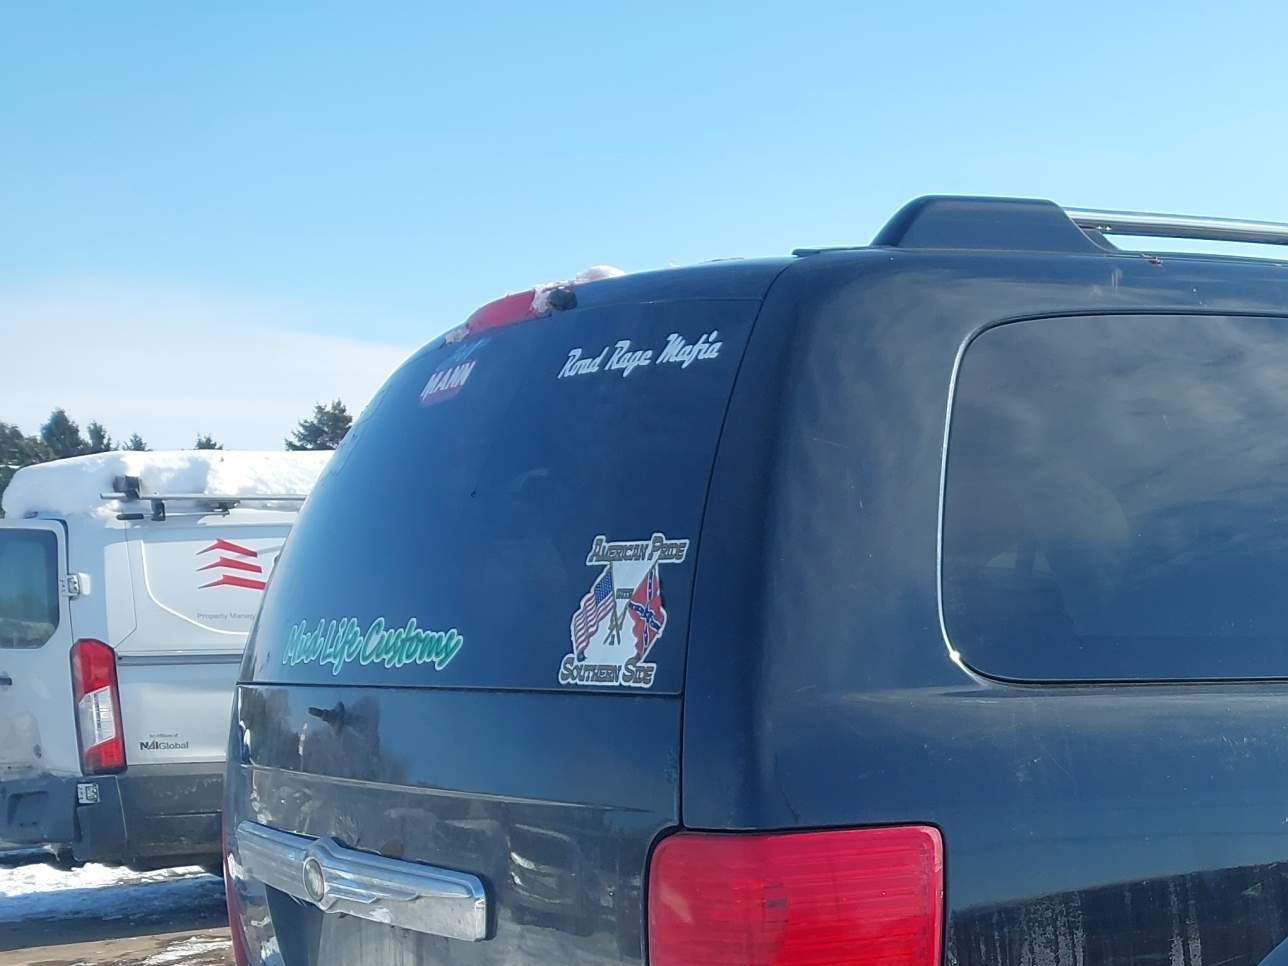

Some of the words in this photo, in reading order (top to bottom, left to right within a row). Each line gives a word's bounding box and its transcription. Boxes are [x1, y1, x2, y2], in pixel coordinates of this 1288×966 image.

[557, 346, 609, 379] Road
[604, 339, 653, 378] Rage
[655, 329, 723, 369] Mafia
[282, 619, 325, 667] Mud
[319, 617, 364, 675] Life
[359, 616, 464, 671] Customs
